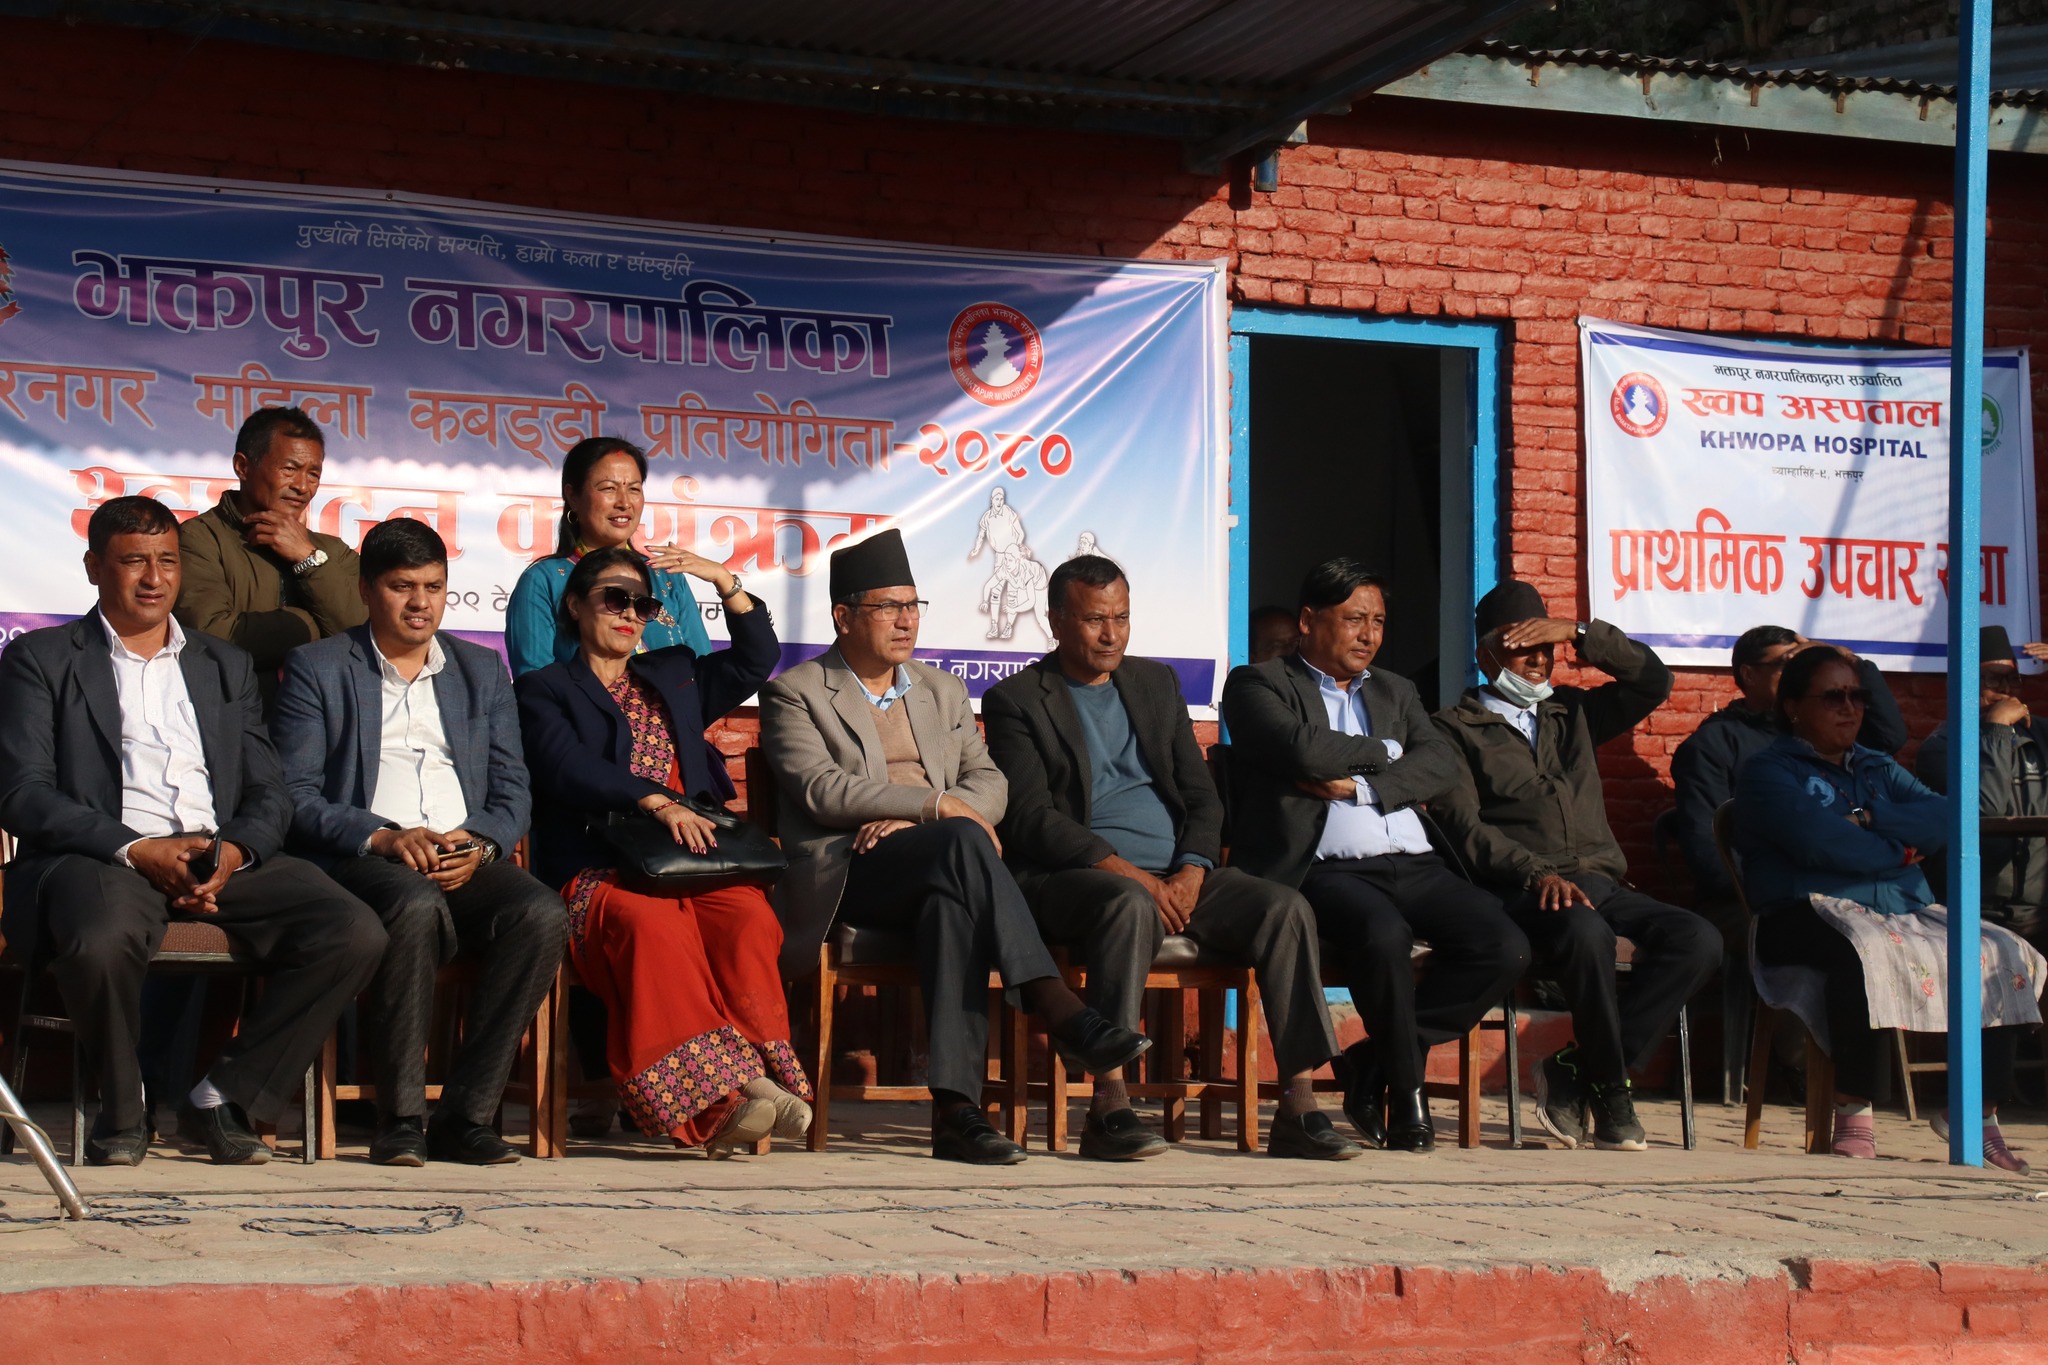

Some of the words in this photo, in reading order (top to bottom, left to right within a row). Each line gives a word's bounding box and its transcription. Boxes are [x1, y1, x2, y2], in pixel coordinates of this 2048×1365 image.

[296, 221, 362, 248] पुर्खाले
[515, 240, 557, 263] हाम्रो
[562, 249, 602, 268] कला
[607, 253, 622, 269] र
[627, 251, 695, 281] संस्कृति
[72, 250, 383, 361] भक्तपुर
[405, 279, 894, 378] नगरपालिका
[956, 367, 994, 400] BHAKTAPUR
[994, 372, 1035, 401] MUNICIPALITY
[1713, 365, 1751, 381] भक्तपुर
[1754, 368, 1845, 387] नगरपालिकाद्वारा
[1848, 372, 1902, 387] सञ्चालित
[1681, 388, 1764, 418] ख्वप
[1777, 394, 1942, 428] अस्पताल
[639, 391, 1073, 479] प्रतियोगिता-२०८०
[1700, 430, 1806, 453] KHWOPA
[1814, 435, 1928, 459] HOSPITAL
[1835, 469, 1864, 483] भक्तपुर
[1609, 507, 1786, 601] प्राथमिक
[1799, 536, 1925, 606] उपचार
